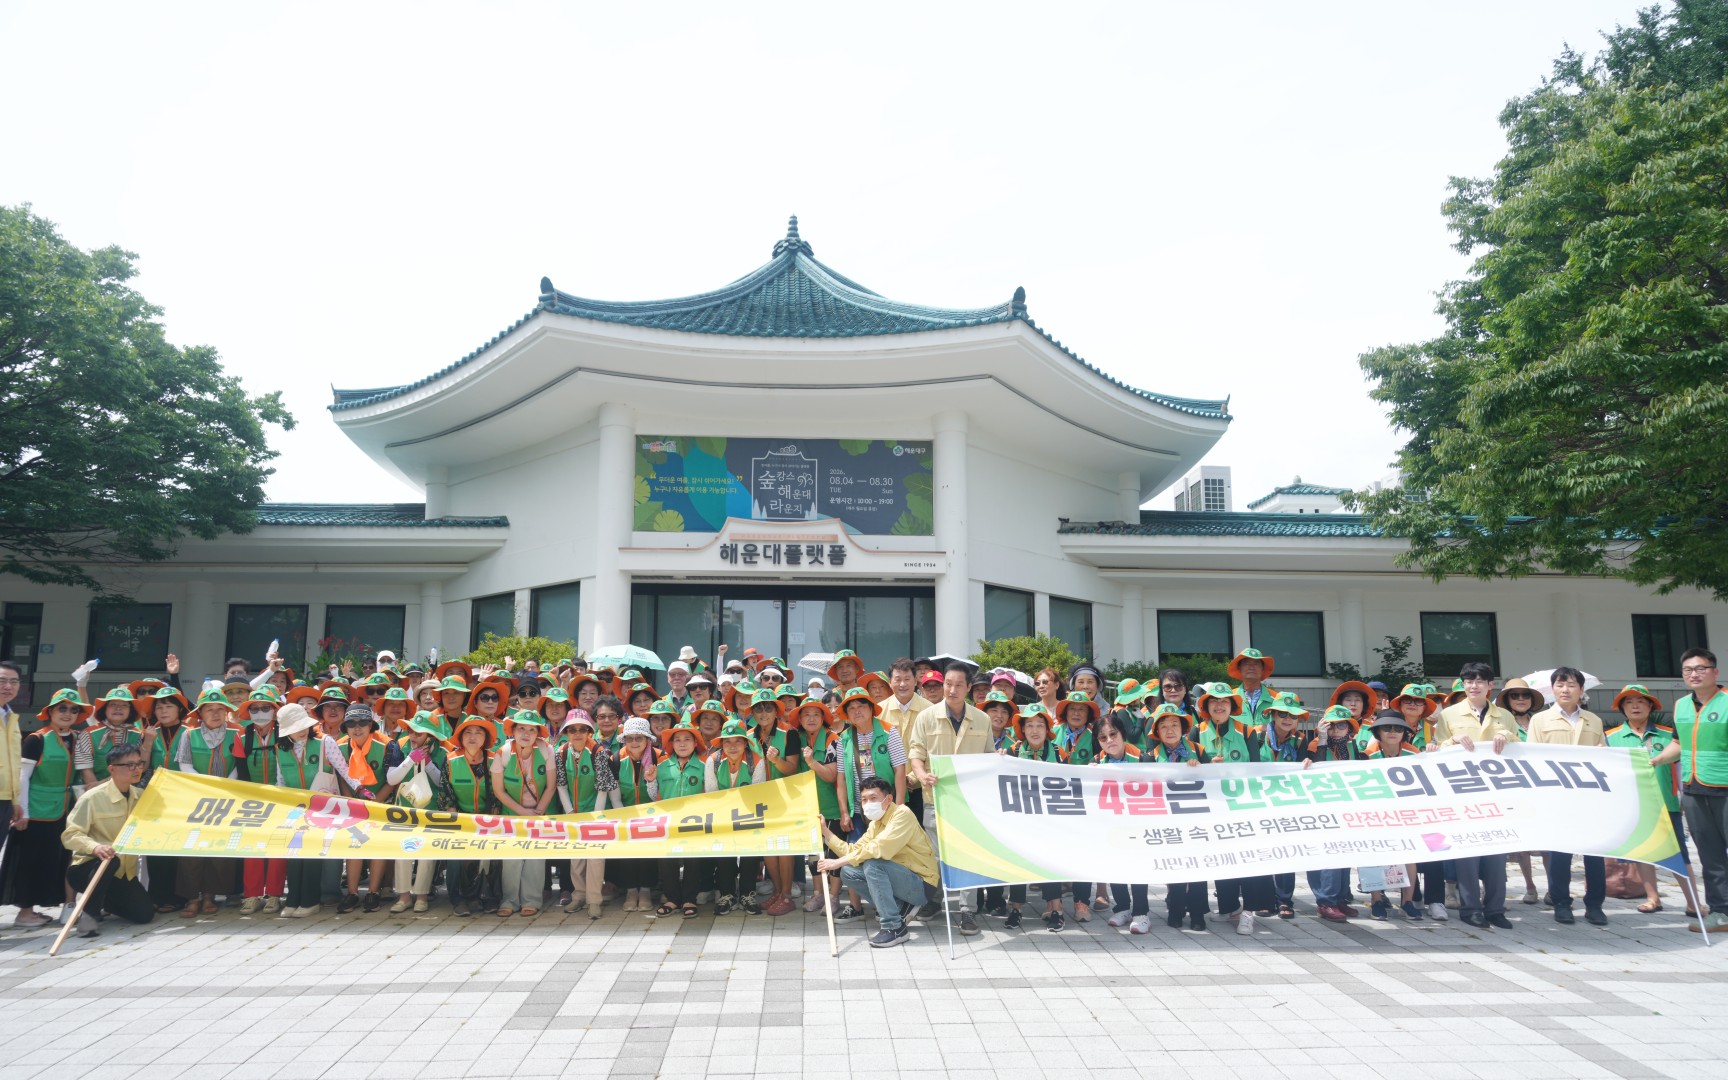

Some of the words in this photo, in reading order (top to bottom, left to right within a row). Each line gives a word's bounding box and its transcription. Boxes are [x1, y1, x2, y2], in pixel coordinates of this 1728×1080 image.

[829, 477, 853, 485] 08.04
[778, 485, 811, 500] 해운대
[770, 499, 802, 514] 라운지
[720, 543, 847, 566] 해운대플랫폼
[998, 774, 1087, 816] 매월
[1098, 779, 1211, 816] 4일은
[1221, 764, 1437, 811] 안전점검의
[1437, 758, 1612, 794] 날입니다
[186, 797, 276, 827] 매월
[731, 803, 768, 831] 날
[1143, 828, 1183, 846] 생활
[1189, 825, 1209, 842] 속
[1213, 820, 1256, 841] 안전
[1259, 814, 1340, 834] 위험요인
[1342, 807, 1462, 828] 안전신문고로
[1464, 802, 1504, 820] 신고
[431, 838, 506, 850] 해운대구
[1451, 829, 1520, 845] 부산광역시
[1153, 856, 1200, 872] 시민과
[1203, 852, 1237, 868] 함께
[1239, 844, 1319, 863] 만들어가는
[1323, 838, 1416, 856] 생활안전도시
